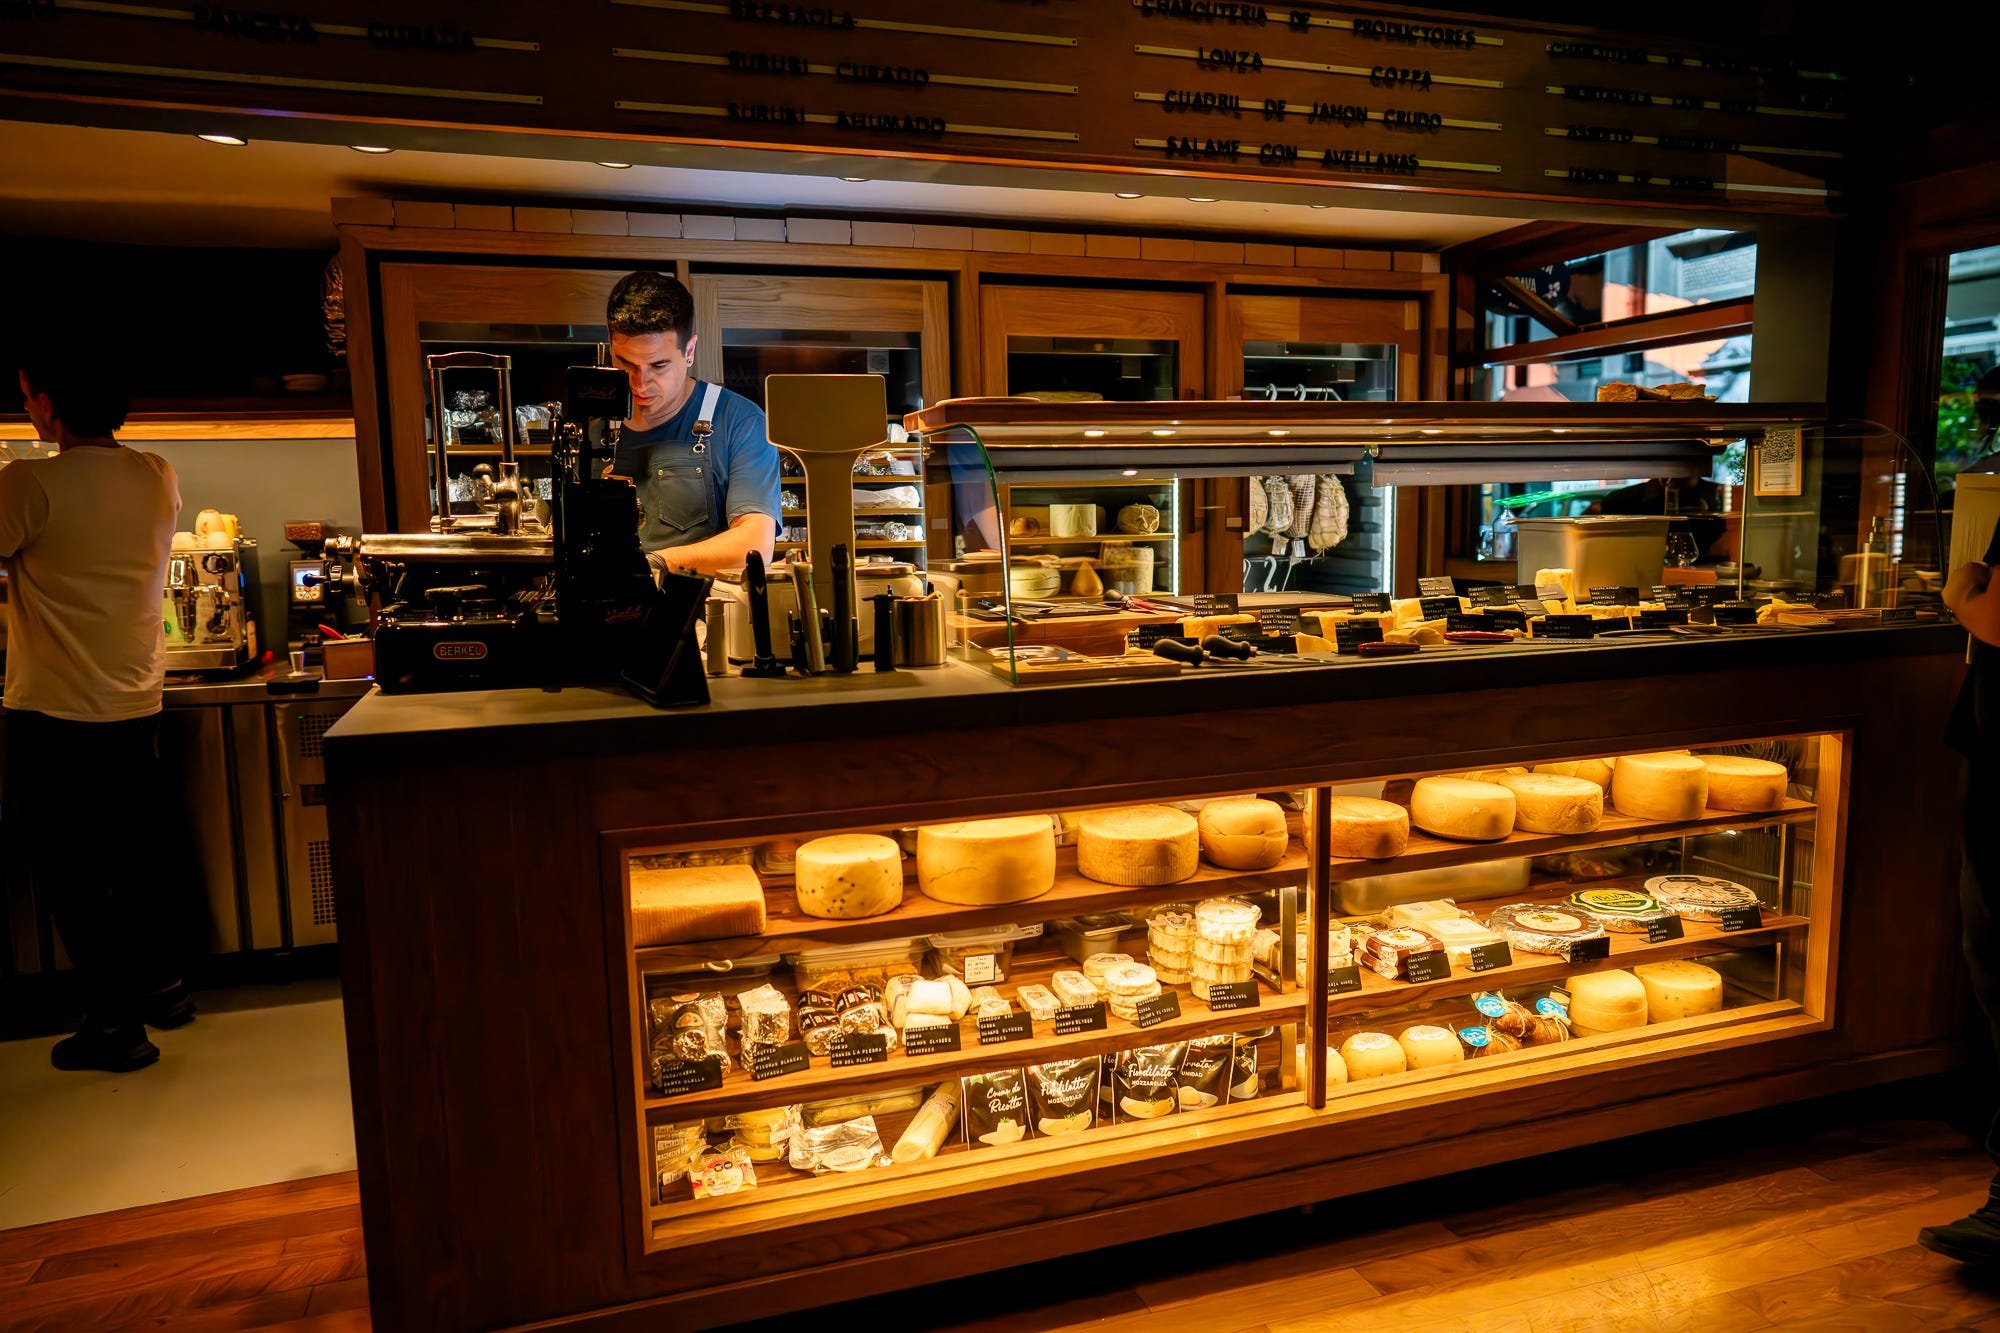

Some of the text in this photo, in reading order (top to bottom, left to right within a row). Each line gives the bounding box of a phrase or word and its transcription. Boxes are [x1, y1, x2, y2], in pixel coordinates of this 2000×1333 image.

[1354, 19, 1475, 46] PRODUCTORES
[836, 62, 929, 85] CURADO
[1198, 47, 1432, 87] LONZA COPPA
[1164, 90, 1442, 129] CUADRIL DE JAMON CRUDO
[836, 110, 947, 135] AHUMADO
[1166, 136, 1419, 171] SALAME CON AVELLANAS
[440, 646, 481, 656] BERKEL
[780, 1056, 803, 1065] BLANCAS
[856, 1056, 873, 1064] PLATA
[1128, 1063, 1176, 1079] Fiordilatte
[989, 1096, 1023, 1113] Ricotta
